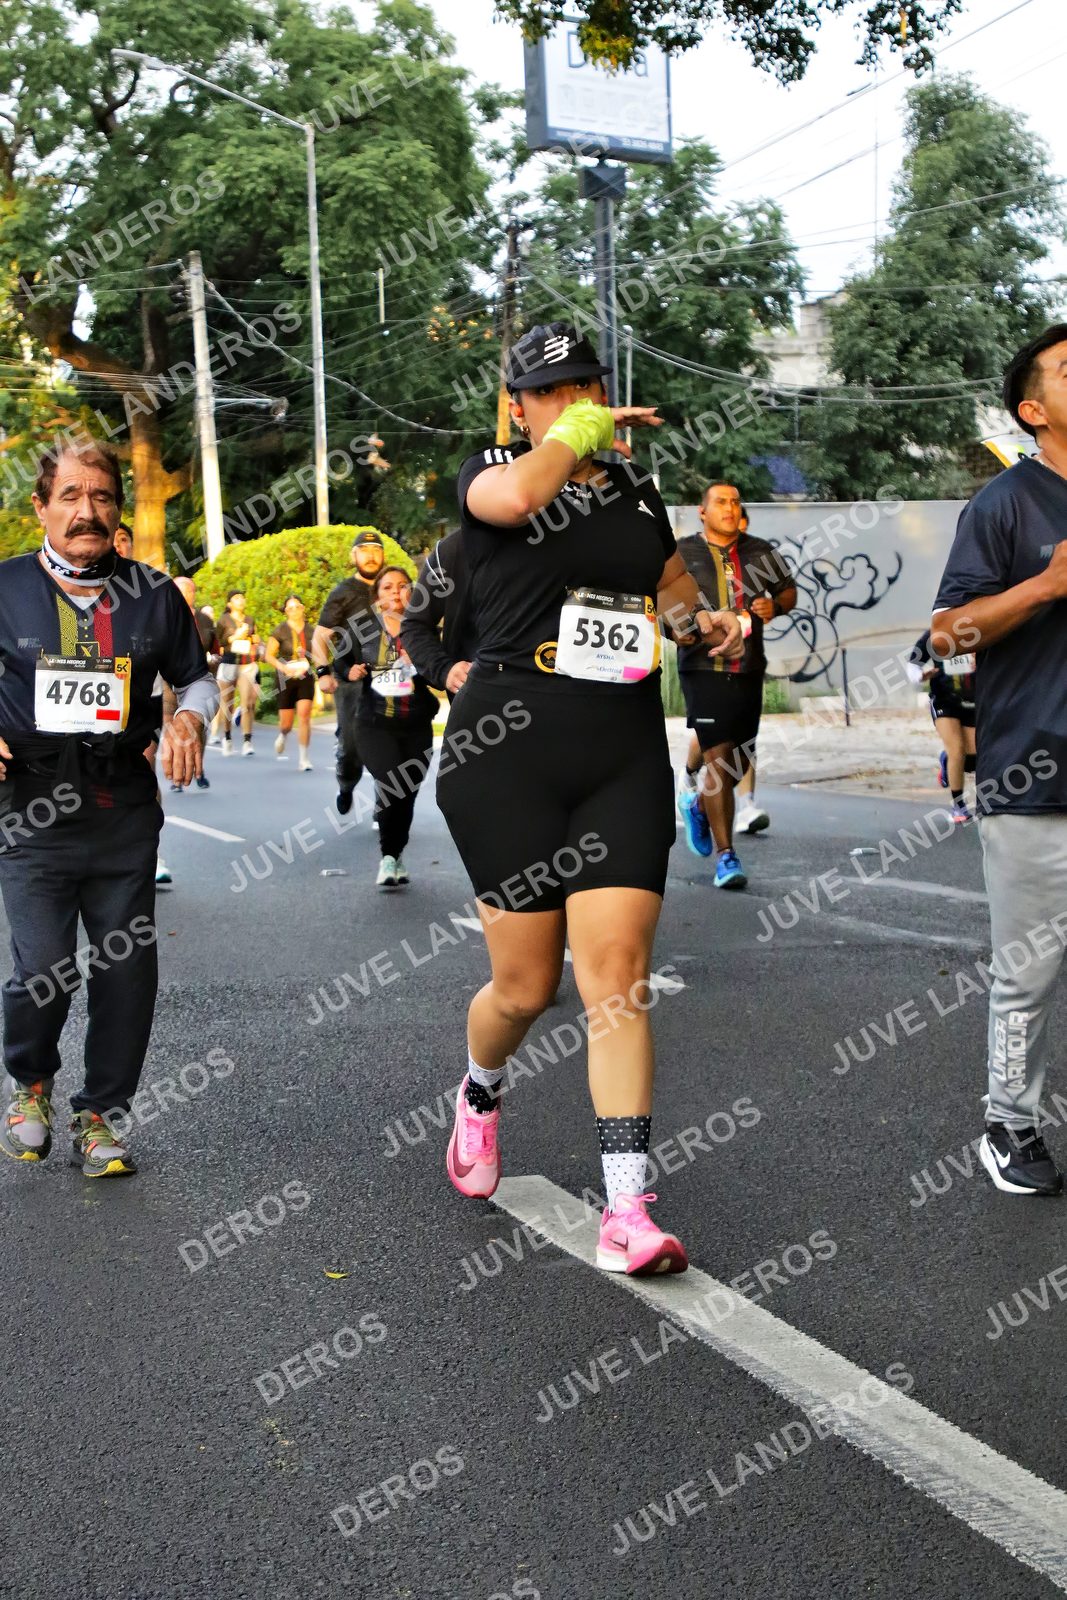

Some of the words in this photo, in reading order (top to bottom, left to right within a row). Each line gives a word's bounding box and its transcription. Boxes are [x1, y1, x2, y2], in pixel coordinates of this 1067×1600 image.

[573, 618, 640, 653] 5362
[46, 680, 110, 706] 4768
[1007, 1011, 1028, 1089] ARMOUR
